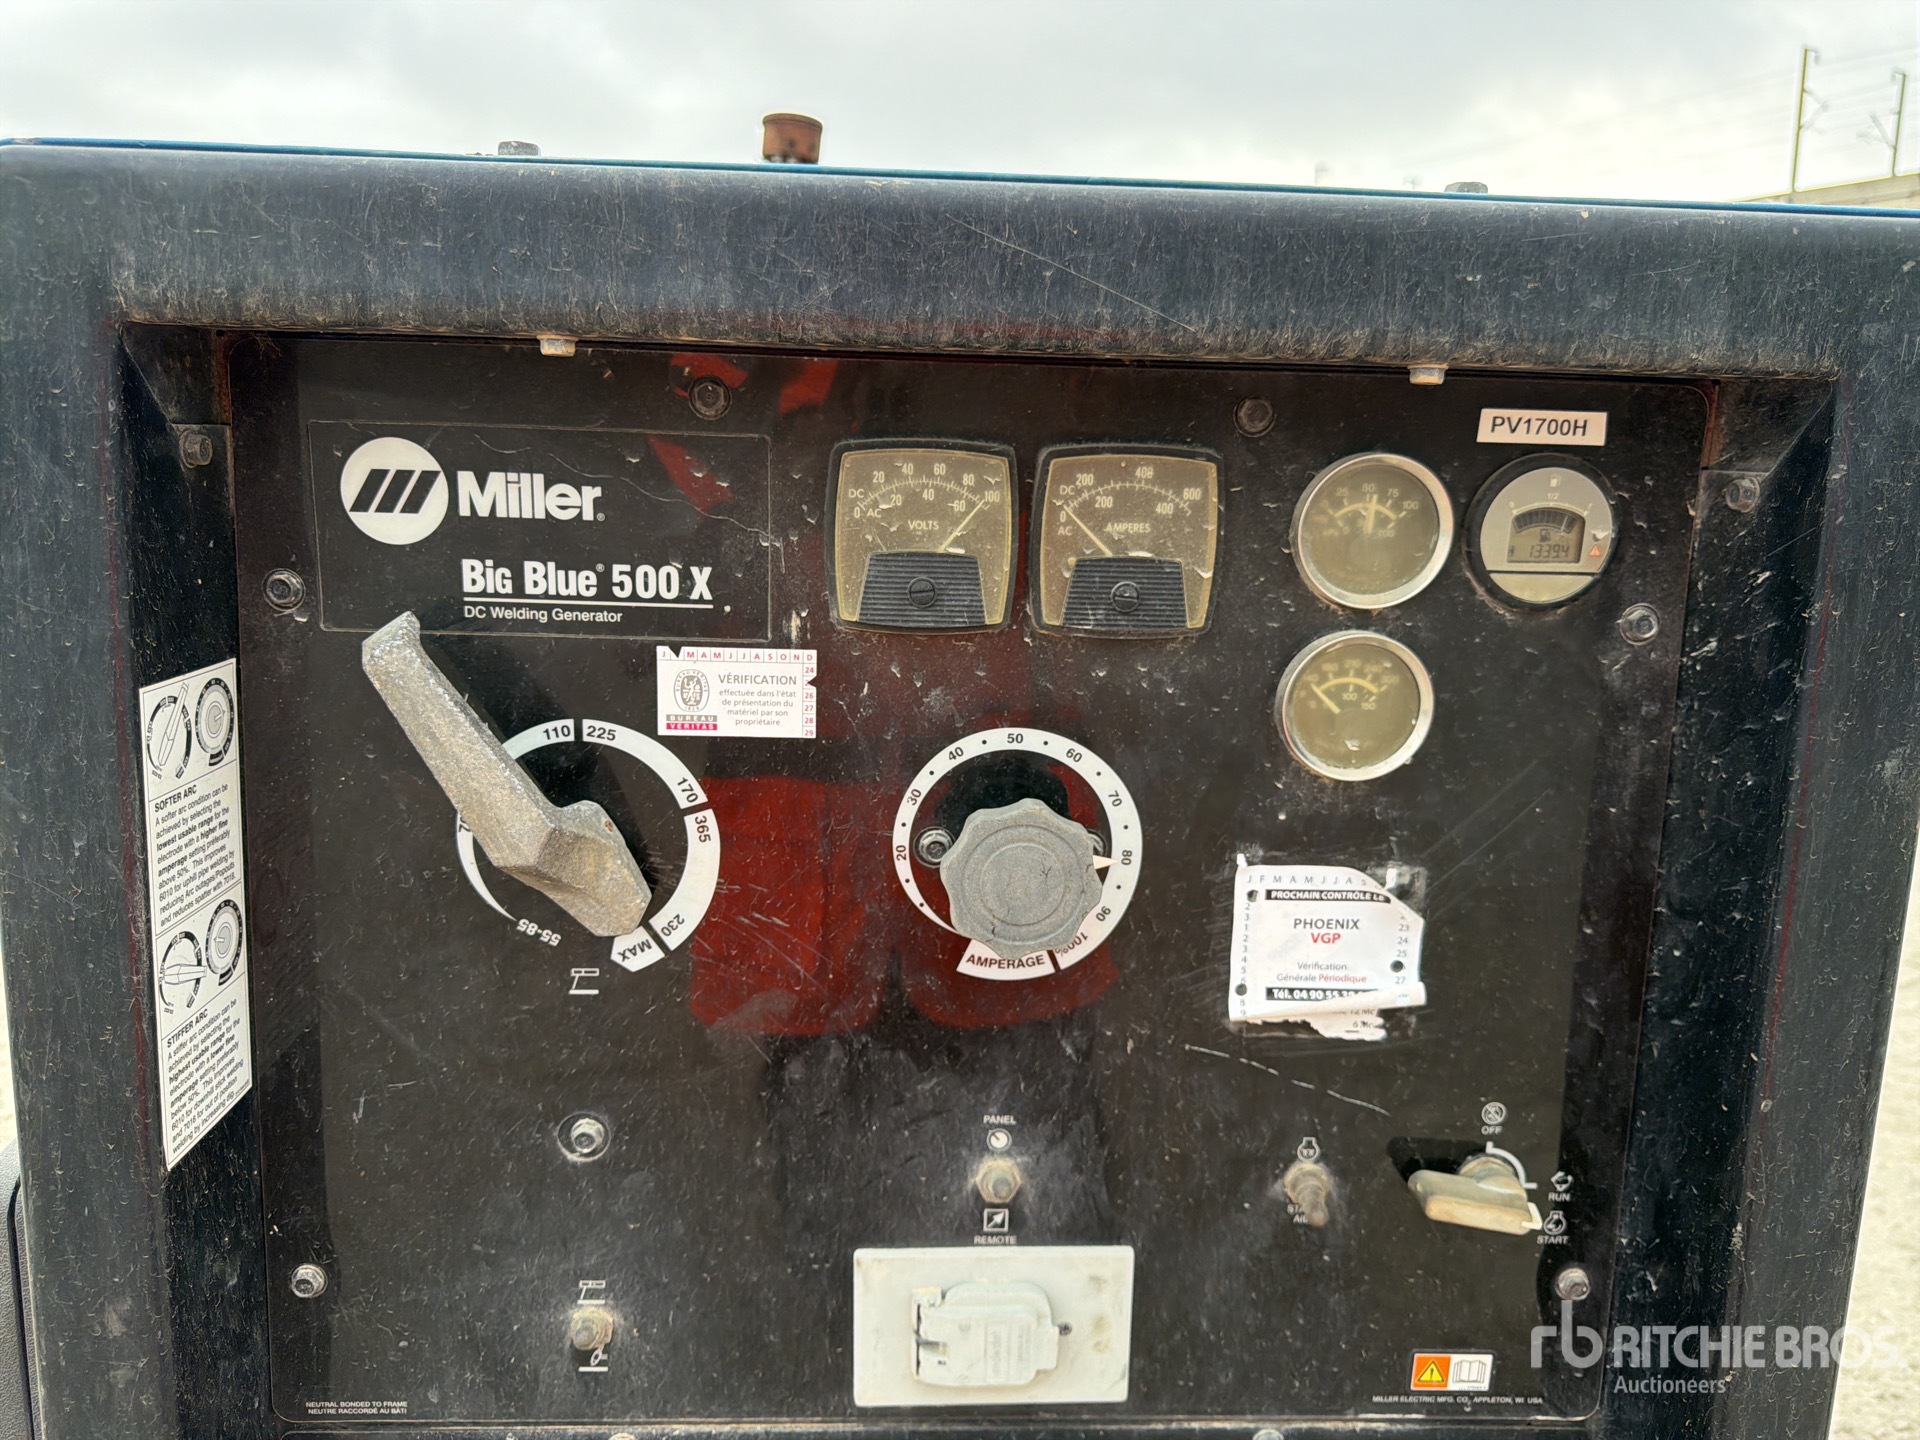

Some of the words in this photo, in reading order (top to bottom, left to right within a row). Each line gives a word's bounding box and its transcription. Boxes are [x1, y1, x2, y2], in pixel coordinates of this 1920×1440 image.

[1491, 416, 1587, 436] PV1700H
[902, 464, 913, 475] 40
[934, 463, 945, 475] 60
[873, 471, 884, 482] 20
[963, 474, 974, 485] 80
[1076, 474, 1094, 485] 200
[849, 490, 864, 498] DC
[923, 489, 934, 500] 40
[1060, 486, 1075, 495] DC
[1183, 488, 1200, 500] 600
[1388, 489, 1399, 498] 75
[891, 495, 902, 506] 20
[984, 491, 999, 502] 100
[1095, 496, 1112, 508] 200
[954, 500, 965, 511] 60
[1156, 503, 1173, 514] 400
[1403, 501, 1419, 510] 100
[854, 507, 860, 518] 0
[867, 509, 882, 517] AC
[1060, 512, 1066, 522] 0
[908, 520, 939, 530] VOLTS
[1058, 526, 1072, 535] AC
[1106, 524, 1150, 532] AMPERES
[462, 559, 512, 593] Big
[612, 564, 679, 599] 500
[690, 566, 712, 600] X
[464, 606, 486, 618] DC
[491, 607, 547, 623] Welding
[552, 608, 622, 622] Generator
[718, 673, 797, 685] VÉRIFICATION
[719, 689, 755, 697] effectuée
[735, 718, 780, 726] propriétaire
[543, 725, 570, 740] 110
[587, 726, 616, 741] 225
[1007, 733, 1023, 744] 50
[948, 747, 964, 761] 40
[1066, 748, 1082, 763] 60
[677, 777, 698, 802] 170
[155, 792, 181, 812] SOFTER
[183, 785, 197, 799] ARC
[188, 793, 211, 809] condition
[212, 788, 221, 797] can
[907, 788, 921, 805] 30
[1108, 790, 1122, 807] 70
[190, 805, 212, 821] selecting
[157, 835, 176, 851] lowest
[178, 825, 197, 839] usable
[198, 816, 213, 829] range
[695, 816, 711, 842] 365
[896, 845, 906, 861] 20
[1121, 850, 1132, 865] 80
[158, 855, 187, 877] amperage
[159, 875, 175, 889] above
[159, 887, 173, 901] 6010
[1271, 891, 1320, 899] PROCHAIN
[1321, 890, 1371, 900] CONTRÔLE
[160, 895, 184, 914] reducing
[1095, 906, 1111, 921] 90
[661, 914, 685, 937] 230
[1294, 919, 1359, 930] PHOENIX
[1311, 933, 1341, 943] VGP
[618, 939, 652, 962] MAX
[966, 954, 1045, 969] AMPERAGE
[1298, 962, 1347, 970] Vérification
[1277, 973, 1316, 982] Générale
[1319, 974, 1366, 983] Périodique
[1395, 976, 1406, 984] 27
[1272, 990, 1291, 998] Tél.
[1293, 990, 1306, 999] 04
[1309, 991, 1323, 999] 90
[167, 1021, 193, 1048] STIFFER
[195, 1009, 208, 1025] ARC
[984, 1115, 1017, 1125] PANEL
[1482, 1126, 1502, 1134] OFF
[1549, 1193, 1569, 1201] RUN
[974, 1235, 1017, 1244] REMOTE
[1537, 1236, 1569, 1244] START
